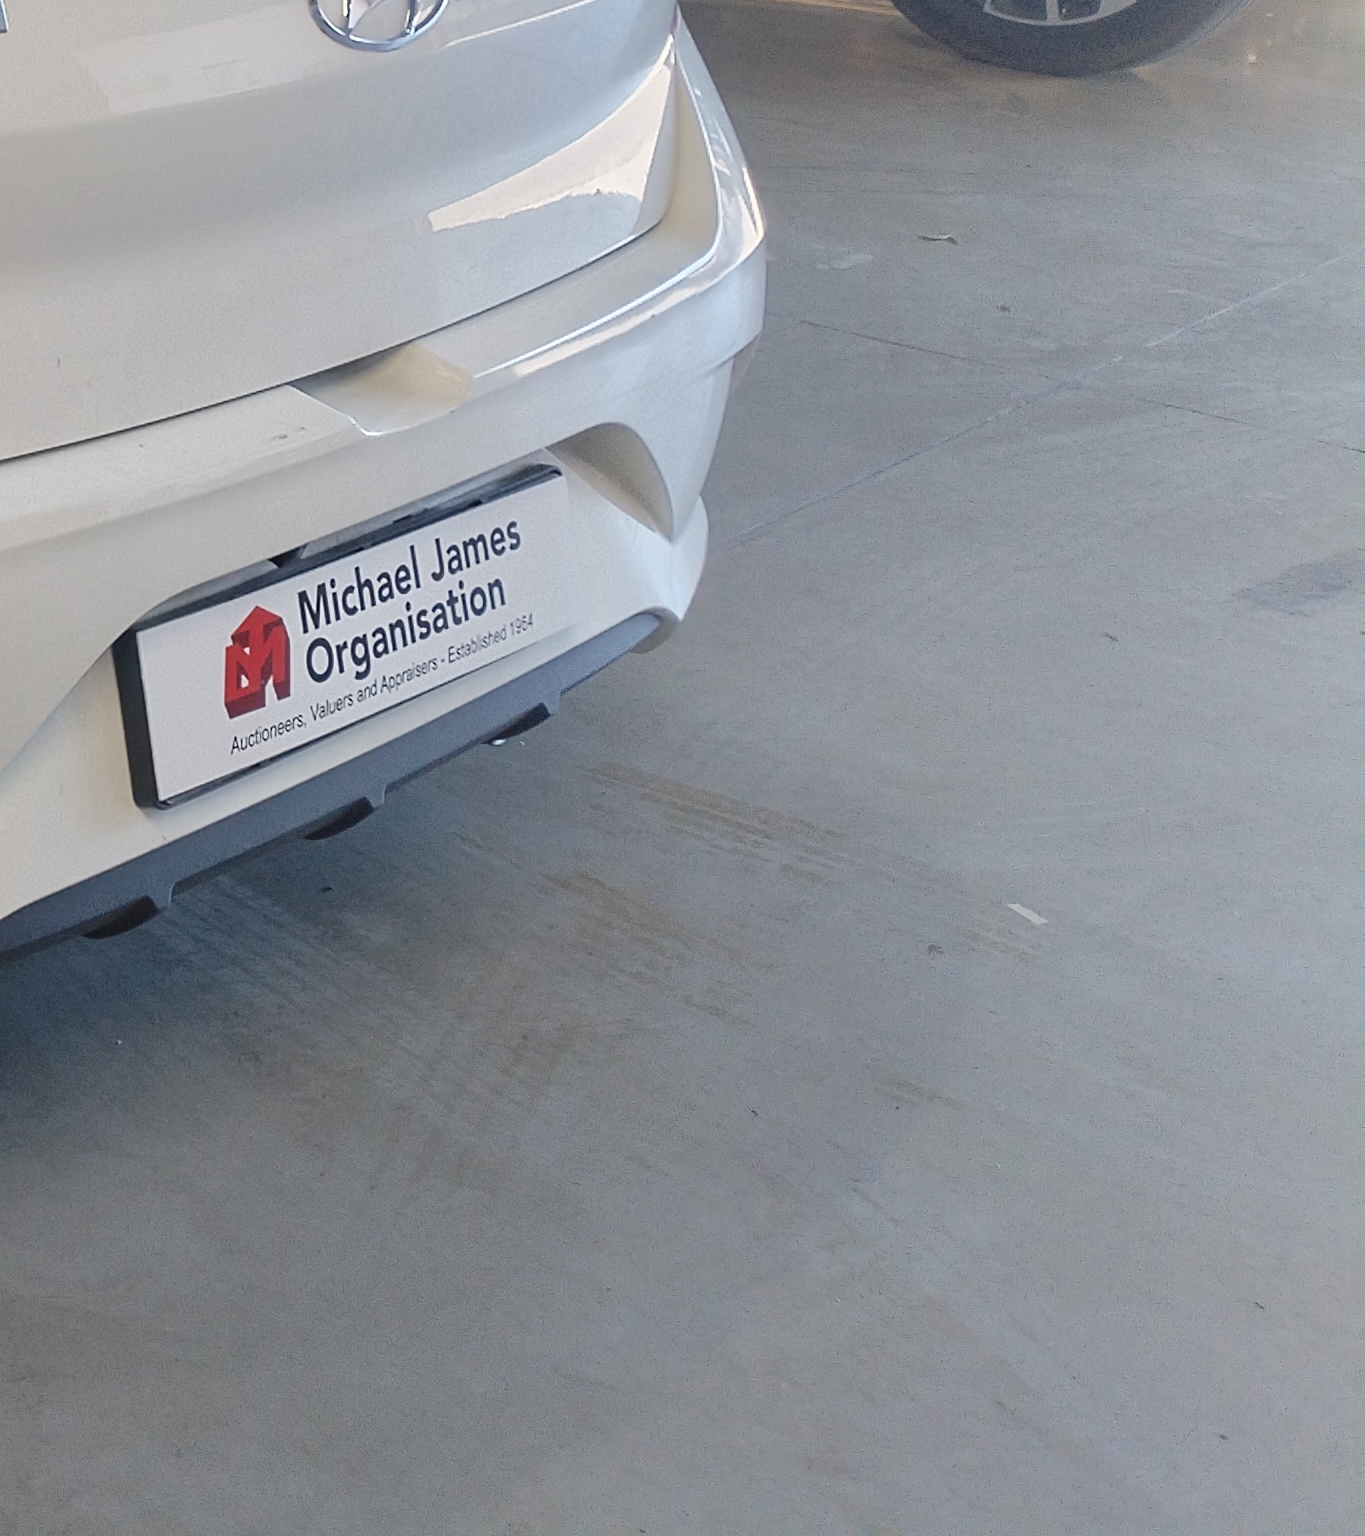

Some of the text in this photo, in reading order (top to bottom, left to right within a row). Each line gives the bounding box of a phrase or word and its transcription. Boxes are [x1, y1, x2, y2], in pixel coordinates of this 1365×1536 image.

[297, 520, 521, 634] Michael James
[306, 578, 506, 683] Organisation
[230, 712, 308, 755] Auctioneers,
[309, 691, 354, 722] Valuers
[356, 678, 378, 703] and
[379, 655, 439, 695] Appraisers
[447, 625, 507, 664] Established
[509, 613, 535, 637] 1964
